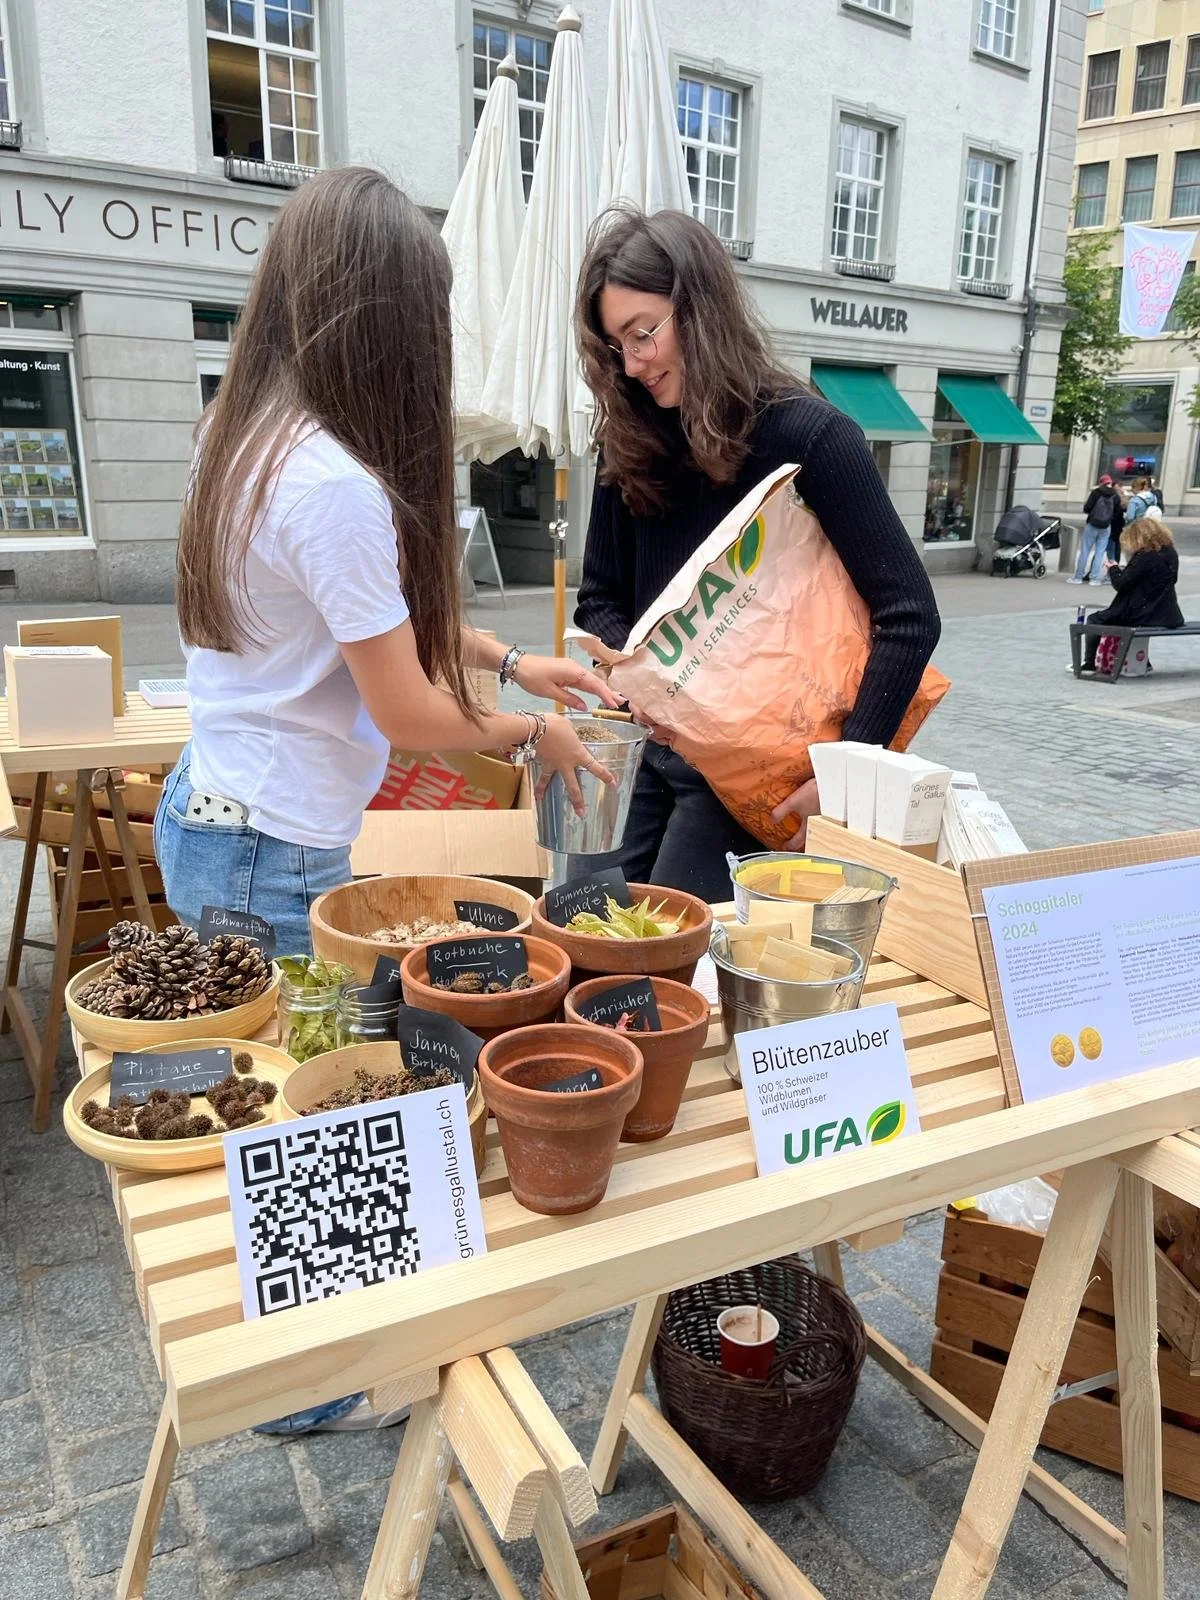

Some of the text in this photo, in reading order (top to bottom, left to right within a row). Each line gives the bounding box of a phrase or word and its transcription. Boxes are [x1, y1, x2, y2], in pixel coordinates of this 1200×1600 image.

[102, 199, 273, 256] OFFIC
[810, 297, 908, 334] WELLAUER
[34, 360, 61, 371] Kunst
[646, 570, 736, 668] UFA
[666, 655, 701, 698] SAMEN
[703, 583, 758, 652] SEMENCES
[468, 905, 504, 926] Ulme
[564, 896, 602, 918] linde
[997, 891, 1083, 917] Schoggitaler
[1002, 920, 1039, 941] 2024
[433, 943, 508, 962] Rotbuche
[752, 1028, 890, 1075] Blütenzauber
[123, 1060, 203, 1077] Platane
[757, 1081, 774, 1095] 100
[785, 1070, 829, 1088] Schweizer
[758, 1085, 812, 1106] Wildblumen
[761, 1092, 828, 1117] und Wildgräser
[784, 1116, 863, 1165] UFA
[436, 1098, 474, 1259] grünesgallustal.ch
